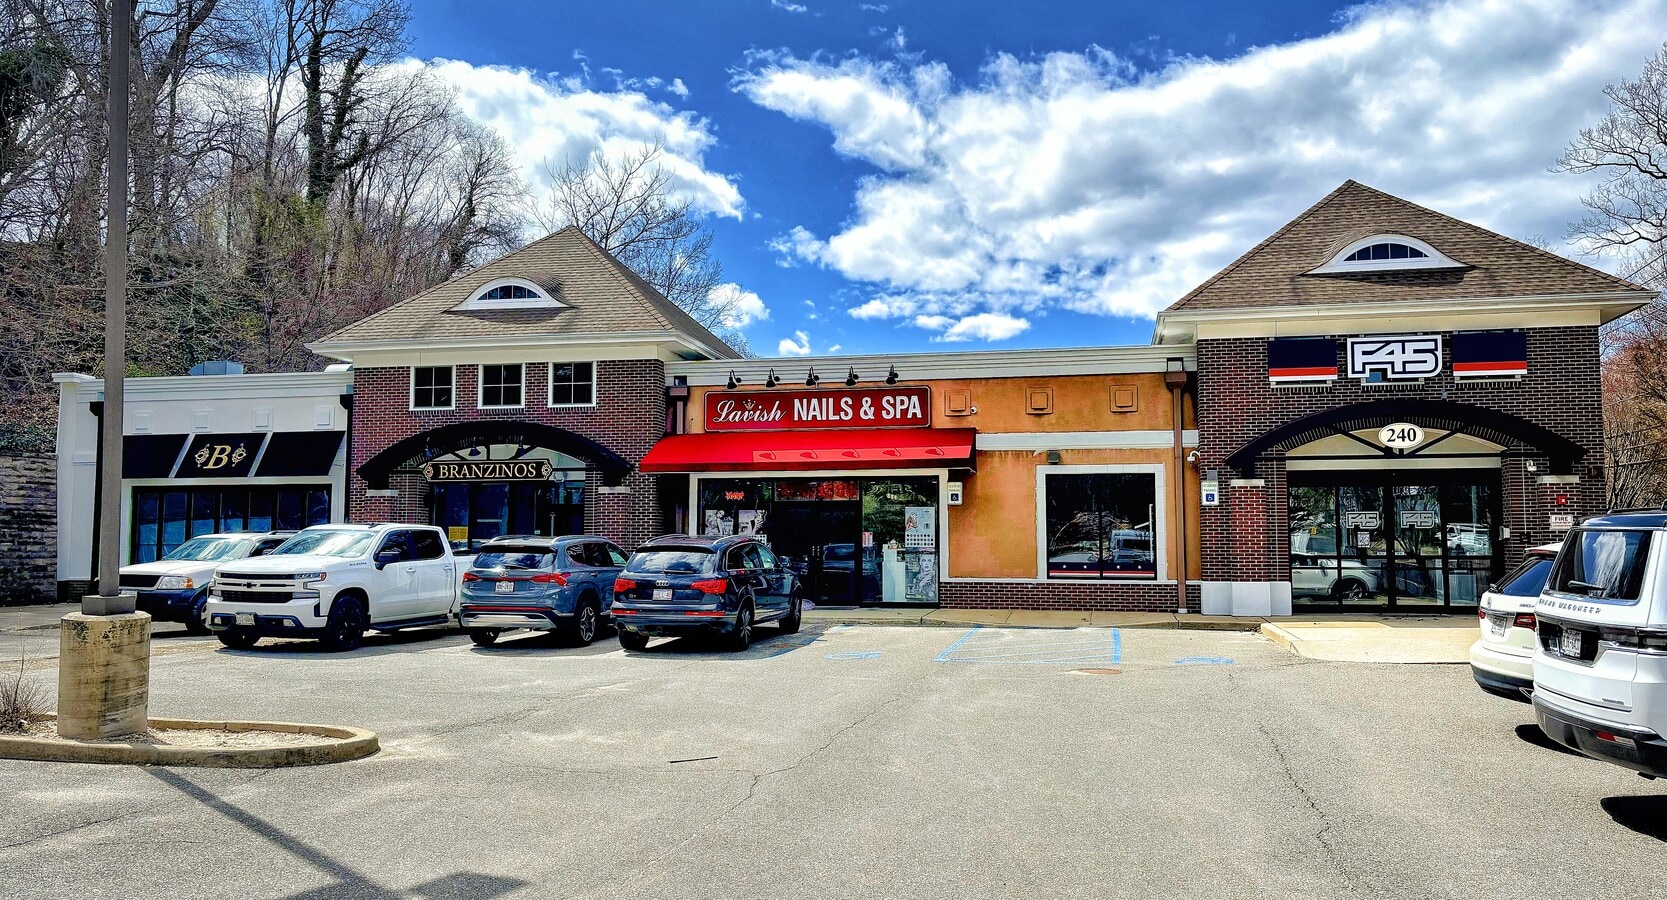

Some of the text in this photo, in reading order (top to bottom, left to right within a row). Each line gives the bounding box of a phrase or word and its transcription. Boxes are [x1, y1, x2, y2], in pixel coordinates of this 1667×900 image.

[1351, 339, 1438, 374] F45
[713, 395, 922, 422] Lavish NAILS & SPA
[1386, 427, 1417, 442] 240
[203, 445, 232, 469] B
[438, 462, 536, 479] BRANZINOS
[1347, 512, 1379, 527] F45
[1402, 512, 1433, 527] F45
